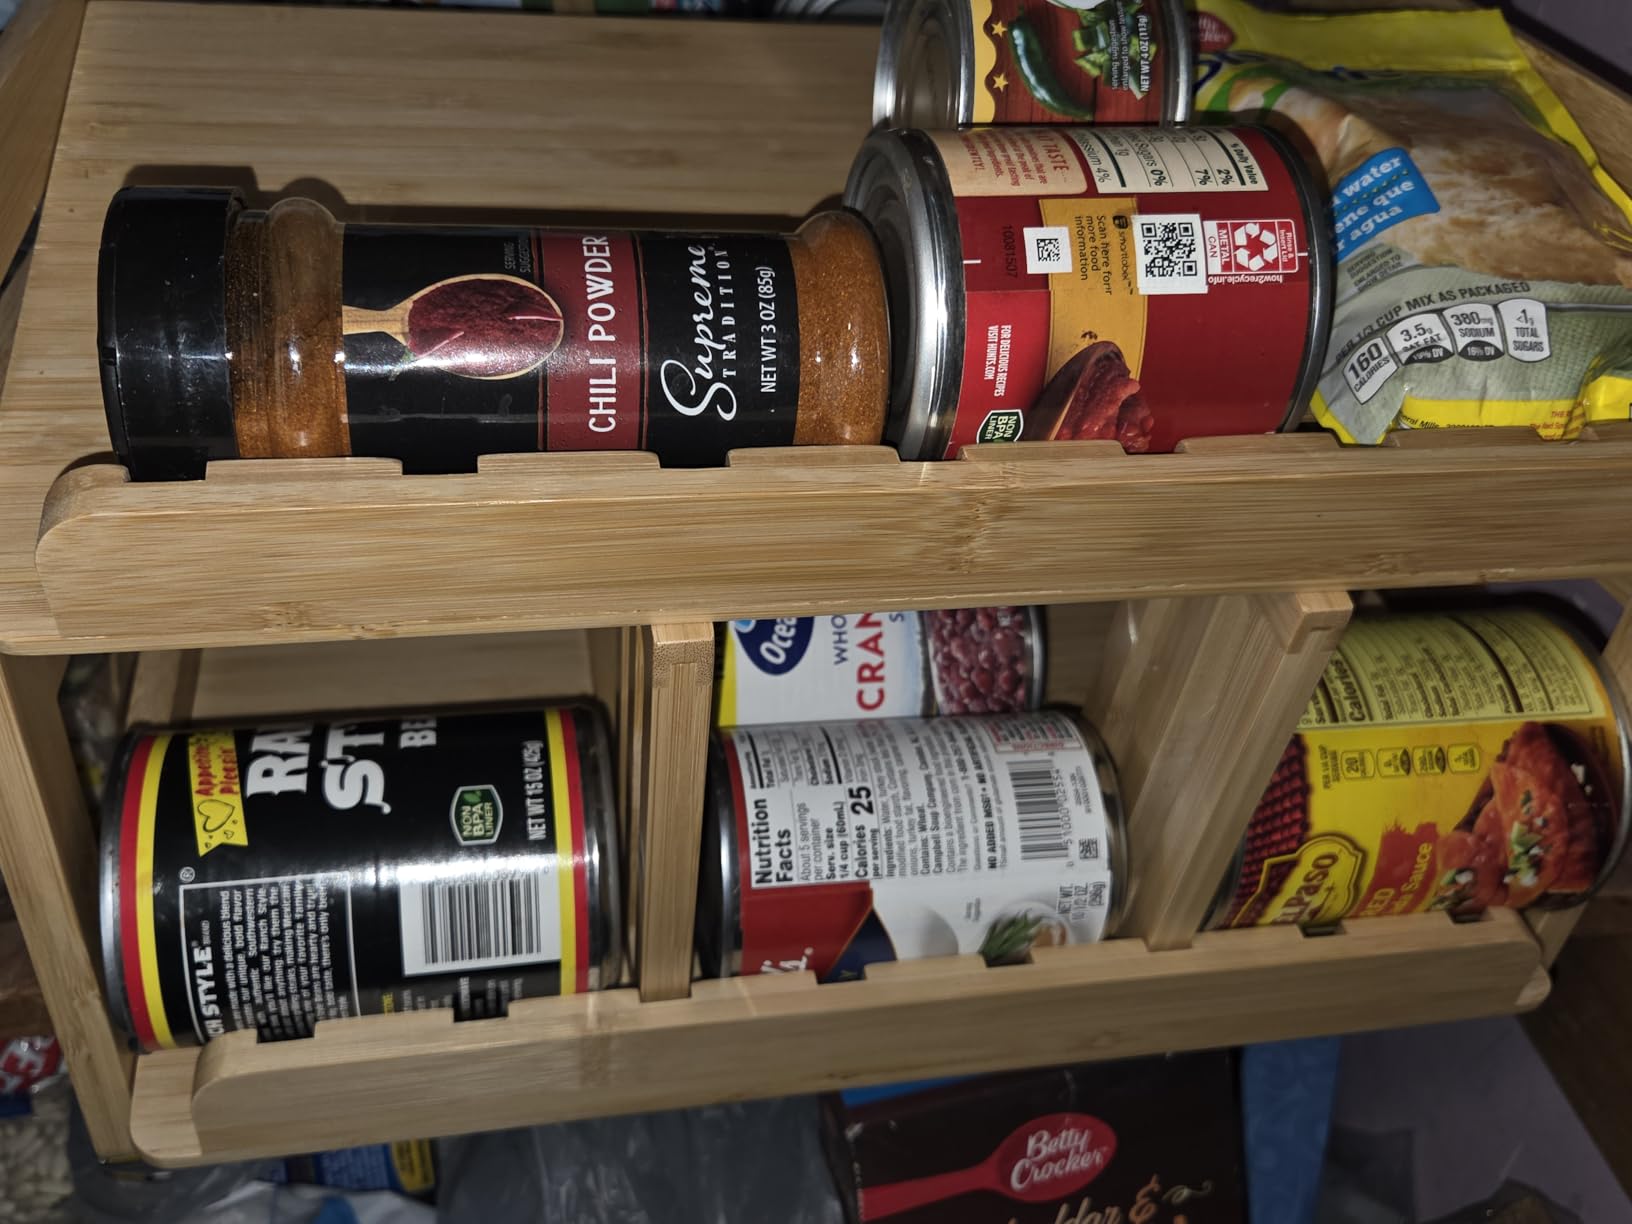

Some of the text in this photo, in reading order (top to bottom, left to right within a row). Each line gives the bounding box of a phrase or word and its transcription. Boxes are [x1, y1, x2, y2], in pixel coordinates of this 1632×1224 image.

[1136, 14, 1150, 40] (113g)
[1121, 46, 1128, 55] to
[1139, 40, 1149, 52] OZ
[1140, 60, 1150, 74] WT
[1140, 75, 1150, 91] NET
[1095, 167, 1112, 183] 4%
[1149, 169, 1167, 186] 0%
[1194, 169, 1213, 185] 7%
[1216, 168, 1234, 185] 2%
[1341, 157, 1401, 197] water
[1373, 180, 1416, 206] que
[1096, 215, 1108, 240] Scan
[1350, 206, 1403, 241] agua
[1074, 216, 1089, 281] information
[1085, 215, 1101, 272] more food
[1100, 242, 1111, 268] here
[1208, 236, 1218, 258] CAN
[1219, 229, 1231, 264] METAL
[1208, 274, 1284, 285] how2recycle.info
[1376, 306, 1401, 325] CUP
[1404, 295, 1437, 313] MIX
[1439, 291, 1457, 301] AS
[1457, 282, 1531, 301] PACKAGED
[581, 235, 617, 433] CHILI POWDER
[660, 246, 737, 421] Supreme
[755, 266, 777, 393] NET WT 3 OZ (85g)
[1458, 328, 1494, 338] SODIUM
[1515, 327, 1539, 338] TOTAL
[983, 325, 999, 380] VISIT HUNTS.COM
[993, 324, 1012, 397] FOR DELICIOUS RECIPES
[1347, 342, 1383, 380] 160
[1513, 340, 1543, 353] SUGARS
[1353, 356, 1391, 393] CALORIES
[984, 415, 998, 440] LINER
[992, 415, 1008, 439] BPA
[1004, 415, 1018, 437] NON
[830, 614, 849, 666] WHO
[1329, 659, 1365, 722] Calories
[1344, 756, 1360, 774] 20
[472, 802, 485, 837] BPA
[483, 801, 494, 837] LINER
[523, 768, 547, 840] NET WT 15 OZ
[462, 805, 472, 837] NON
[796, 802, 810, 843] servings
[847, 785, 875, 879] Calories 25
[975, 772, 997, 870] NO ADDED NO
[751, 798, 773, 885] Nutrition
[773, 828, 794, 883] Facts
[824, 827, 837, 880] Serv. size
[837, 840, 850, 861] cup
[870, 827, 880, 877] per serving
[929, 811, 943, 874] Campbell Soup
[799, 853, 812, 881] About
[1401, 842, 1433, 892] Sauce
[220, 890, 230, 920] blend
[232, 889, 243, 922] flavor
[257, 887, 268, 915] Style
[281, 884, 292, 928] Mexican
[1057, 899, 1072, 915] NET
[234, 924, 245, 947] bold
[260, 919, 270, 951] Ranch
[267, 886, 283, 955] try them the
[307, 910, 318, 931] and
[319, 911, 330, 934] only
[221, 920, 233, 961] delicious
[246, 887, 263, 1005] authentic Southwestern
[284, 928, 295, 964] making
[296, 922, 306, 963] favorite
[309, 932, 320, 964] hearty
[320, 935, 331, 967] there's
[261, 954, 272, 972] our
[299, 965, 310, 987] your
[311, 965, 321, 979] are
[192, 946, 221, 1017] STYLE
[225, 970, 236, 989] with
[240, 987, 250, 1001] our
[263, 974, 274, 991] like
[1026, 1128, 1091, 1160] Betty
[1010, 1148, 1104, 1192] Crocker
